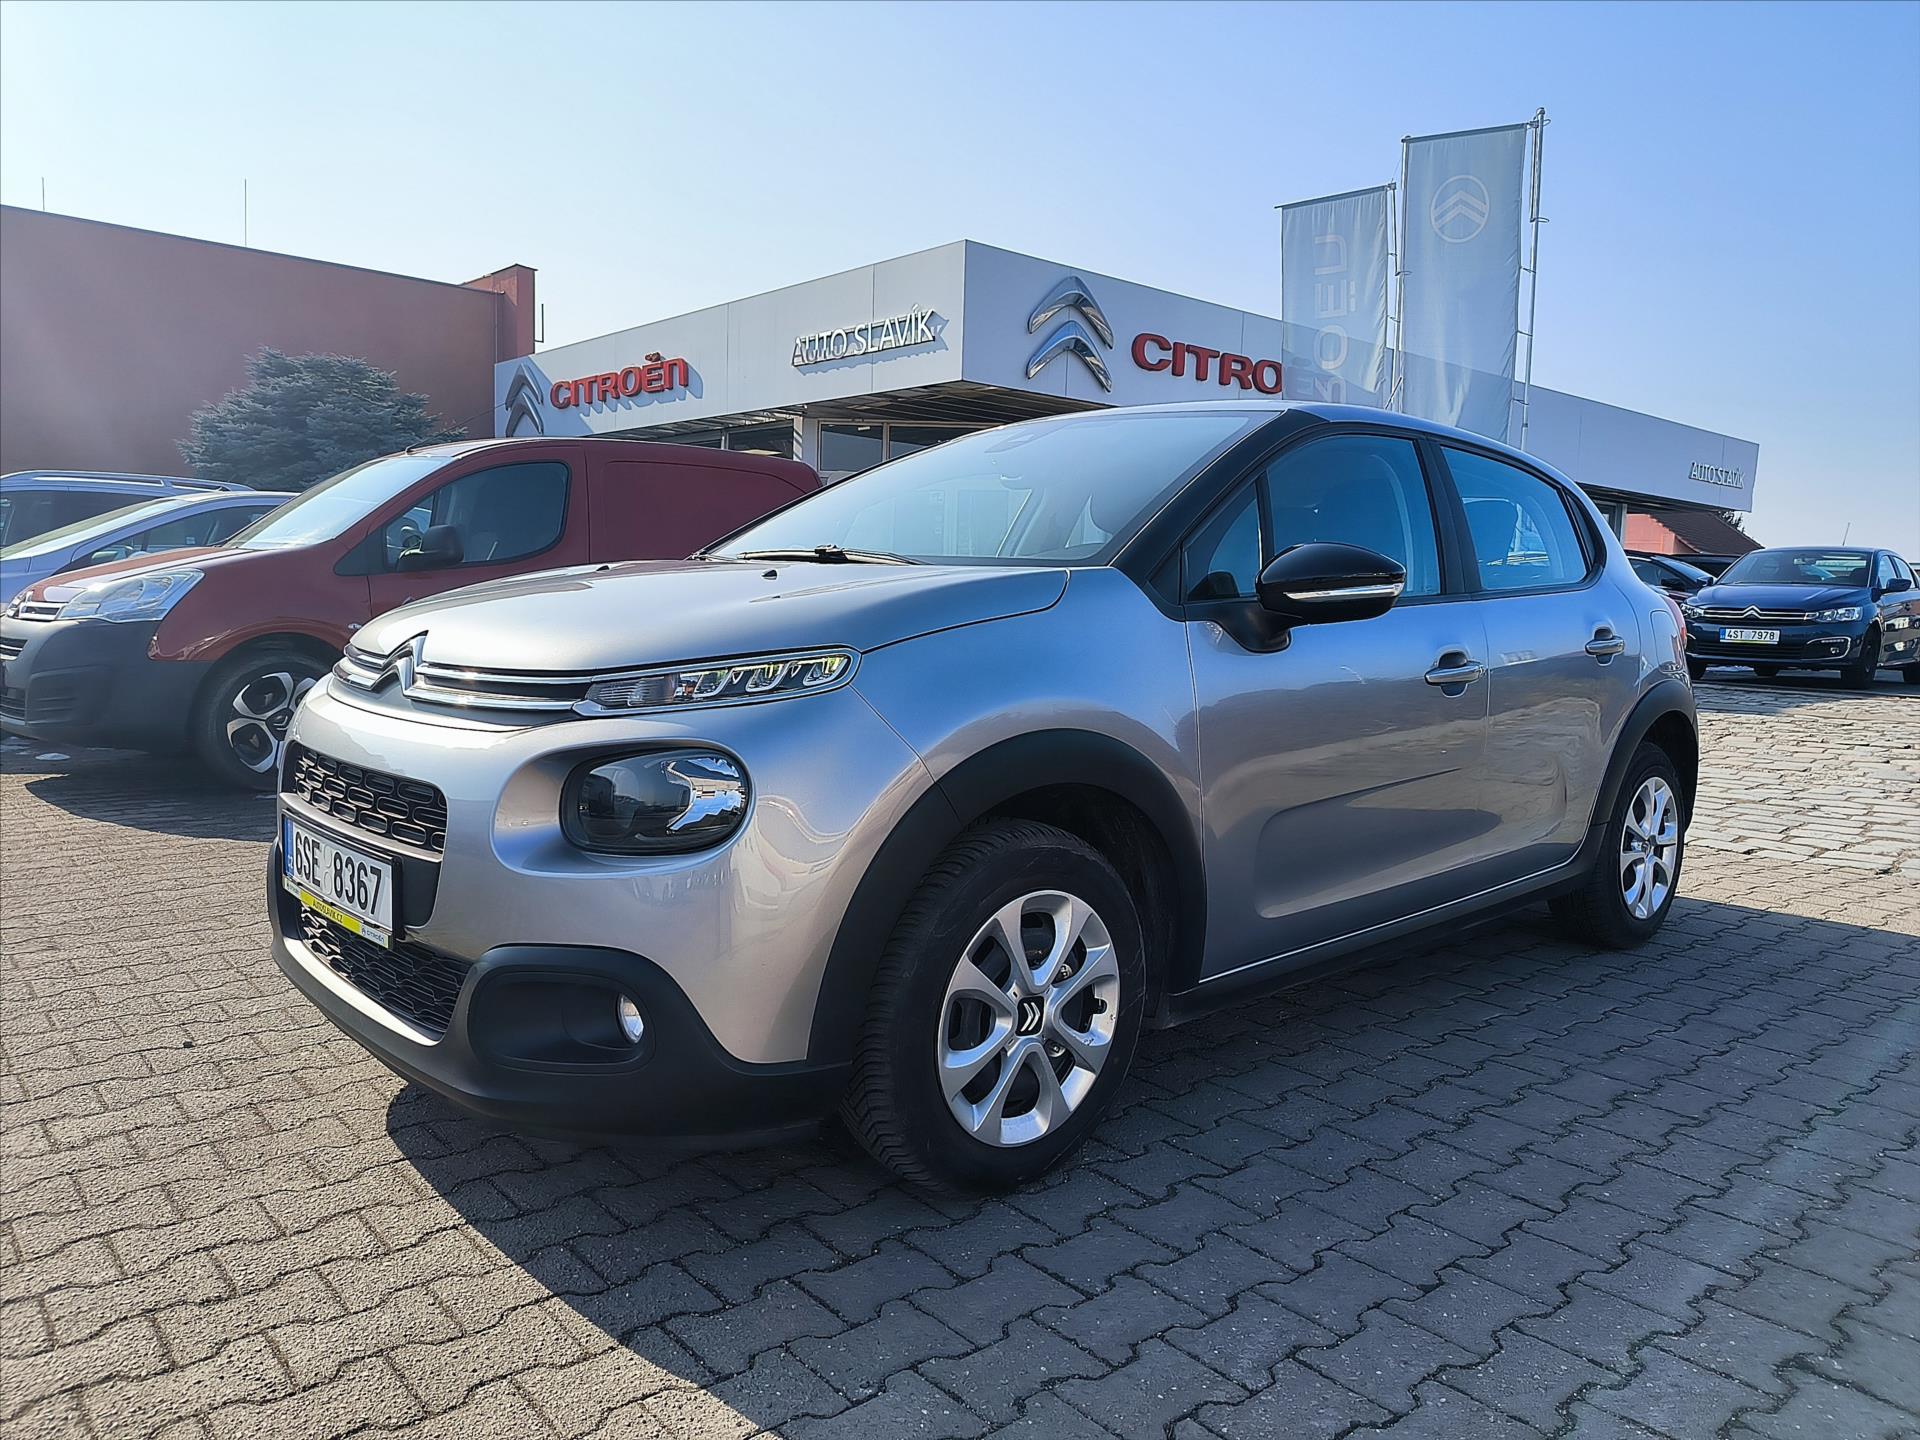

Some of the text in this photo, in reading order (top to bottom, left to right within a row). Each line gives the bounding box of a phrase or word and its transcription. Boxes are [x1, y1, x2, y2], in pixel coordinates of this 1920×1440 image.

[791, 303, 935, 367] AUTO SLAVÍK
[1131, 333, 1283, 394] CITRO
[1691, 461, 1716, 483] AUTO
[1727, 630, 1744, 639] 4ST
[1751, 630, 1775, 640] 7978
[296, 831, 382, 915] 6SE 8367
